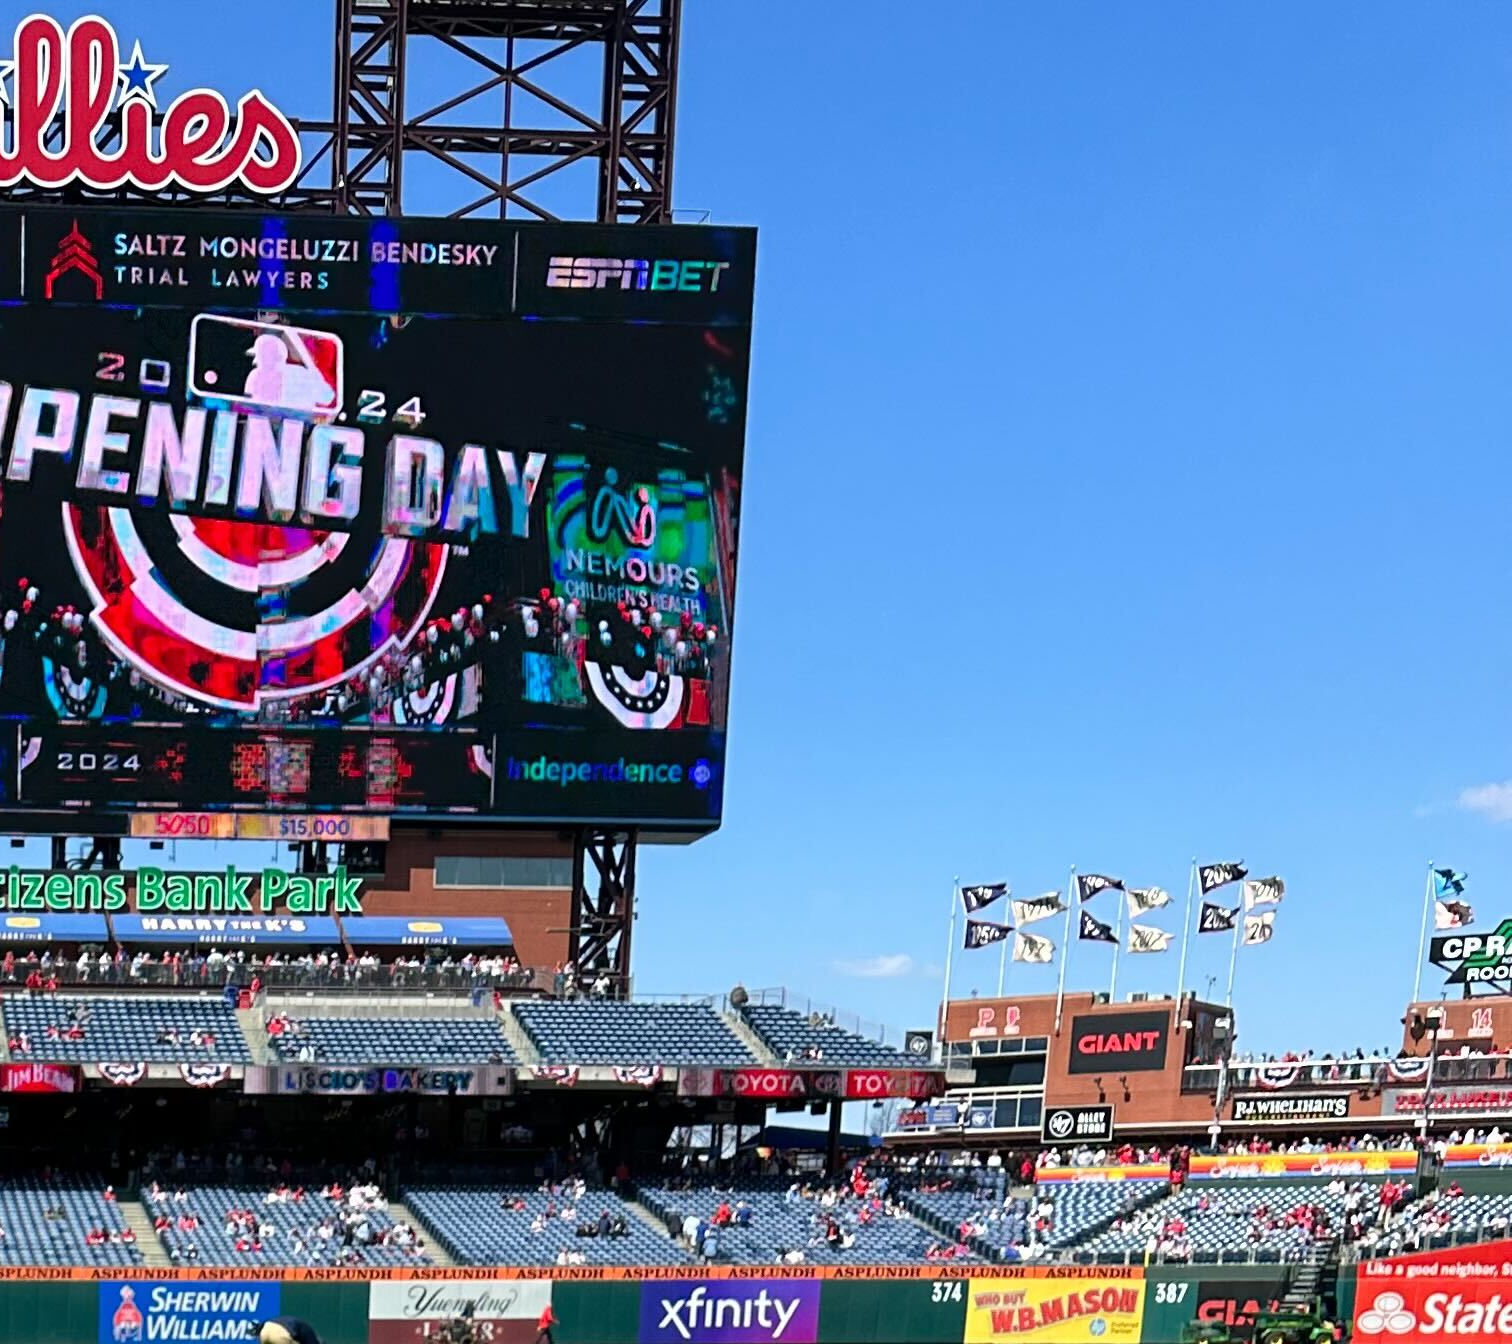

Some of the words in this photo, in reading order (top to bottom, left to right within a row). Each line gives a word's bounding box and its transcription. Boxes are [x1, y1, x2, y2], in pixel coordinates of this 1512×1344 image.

[114, 234, 186, 257] SALTZ
[200, 238, 359, 262] MONGELUZZI
[372, 241, 498, 266] BENDESKY
[114, 267, 188, 286] TRIAL
[212, 270, 329, 290] LAWYERS
[382, 434, 546, 539] DAY
[565, 546, 700, 592] NEMOURS
[565, 578, 647, 609] CHILDREN'S
[650, 591, 701, 617] HEALTH
[57, 752, 141, 771] 2024
[507, 754, 682, 787] Independence
[279, 817, 350, 836] $15,000
[134, 866, 254, 912] Bank
[261, 866, 362, 913] Park
[141, 917, 227, 932] HARRY
[1442, 937, 1482, 960] CP
[1472, 1008, 1492, 1030] 14
[1078, 1031, 1159, 1055] GIANT
[2, 1066, 31, 1092] JIM
[32, 1063, 75, 1093] BEAM
[720, 1074, 806, 1093] TOYOTA
[91, 1269, 180, 1280] ASPLUNDH
[197, 1269, 286, 1280] ASPLUNDH
[303, 1269, 392, 1280] ASPLUNDH
[410, 1269, 498, 1280] ASPLUNDH
[516, 1269, 604, 1280] ASPLUNDH
[623, 1267, 711, 1279] ASPLUNDH
[729, 1267, 816, 1278] ASPLUNDH
[834, 1267, 921, 1278] ASPLUNDH
[939, 1267, 1025, 1278] ASPLUNDH
[1045, 1267, 1132, 1278] ASPLUNDH
[1366, 1262, 1393, 1276] Like
[1406, 1262, 1438, 1278] good
[148, 1286, 260, 1313] SHERWIN
[931, 1281, 963, 1303] 374
[1155, 1282, 1188, 1303] 387
[658, 1286, 801, 1339] xfinity
